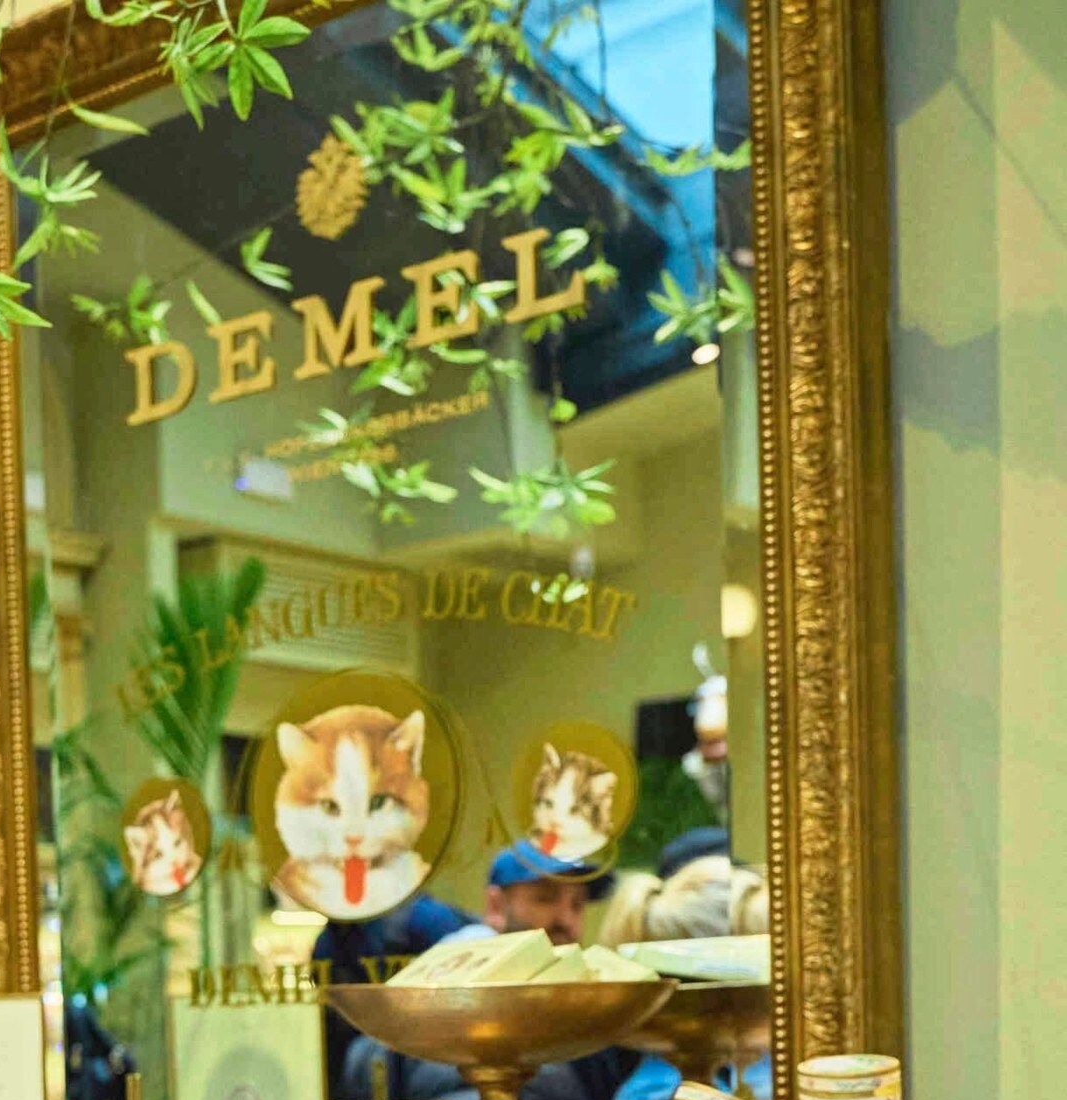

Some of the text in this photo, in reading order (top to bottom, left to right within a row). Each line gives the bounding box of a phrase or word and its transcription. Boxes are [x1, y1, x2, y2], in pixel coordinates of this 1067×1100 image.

[125, 227, 588, 426] DEMEL
[421, 563, 489, 620] DE
[500, 569, 635, 640] CHAT
[188, 961, 330, 1007] DEMEL
